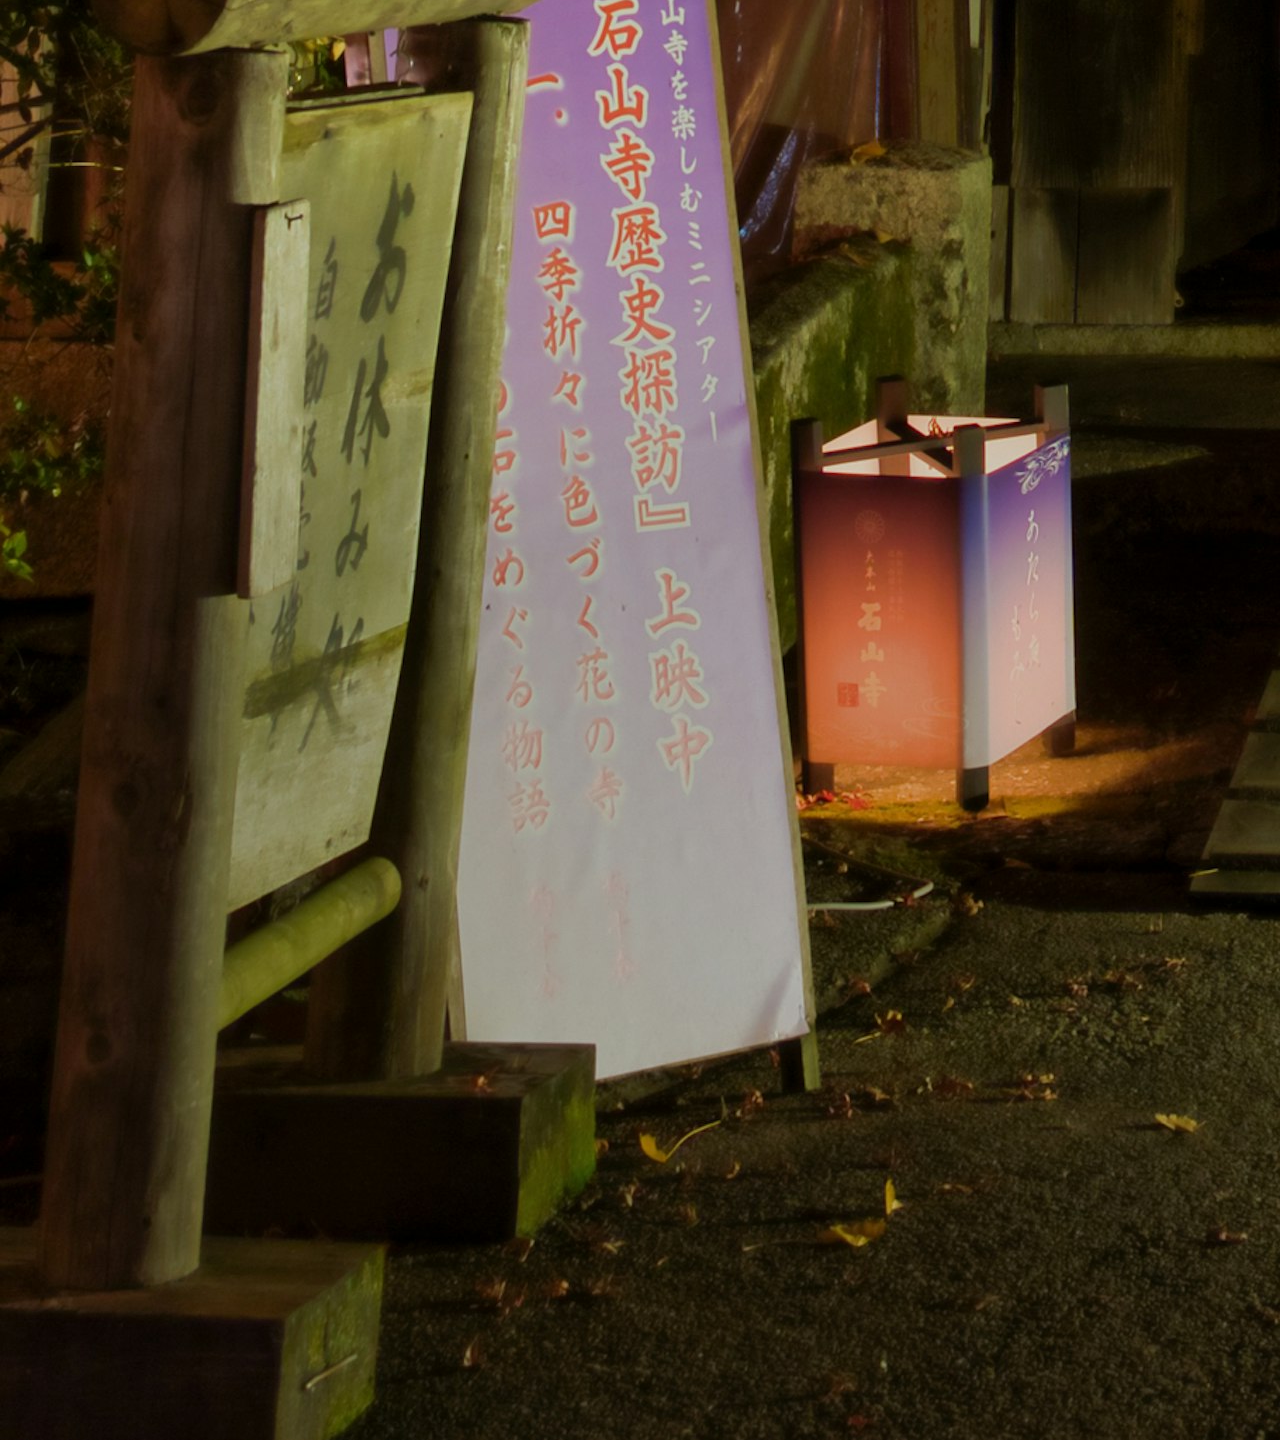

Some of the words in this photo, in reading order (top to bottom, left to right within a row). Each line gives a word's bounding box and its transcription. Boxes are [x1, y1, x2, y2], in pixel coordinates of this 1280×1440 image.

[532, 200, 625, 821] 四季折々に色づく花の寺
[645, 567, 712, 791] 上映中
[857, 602, 887, 708] 石山寺
